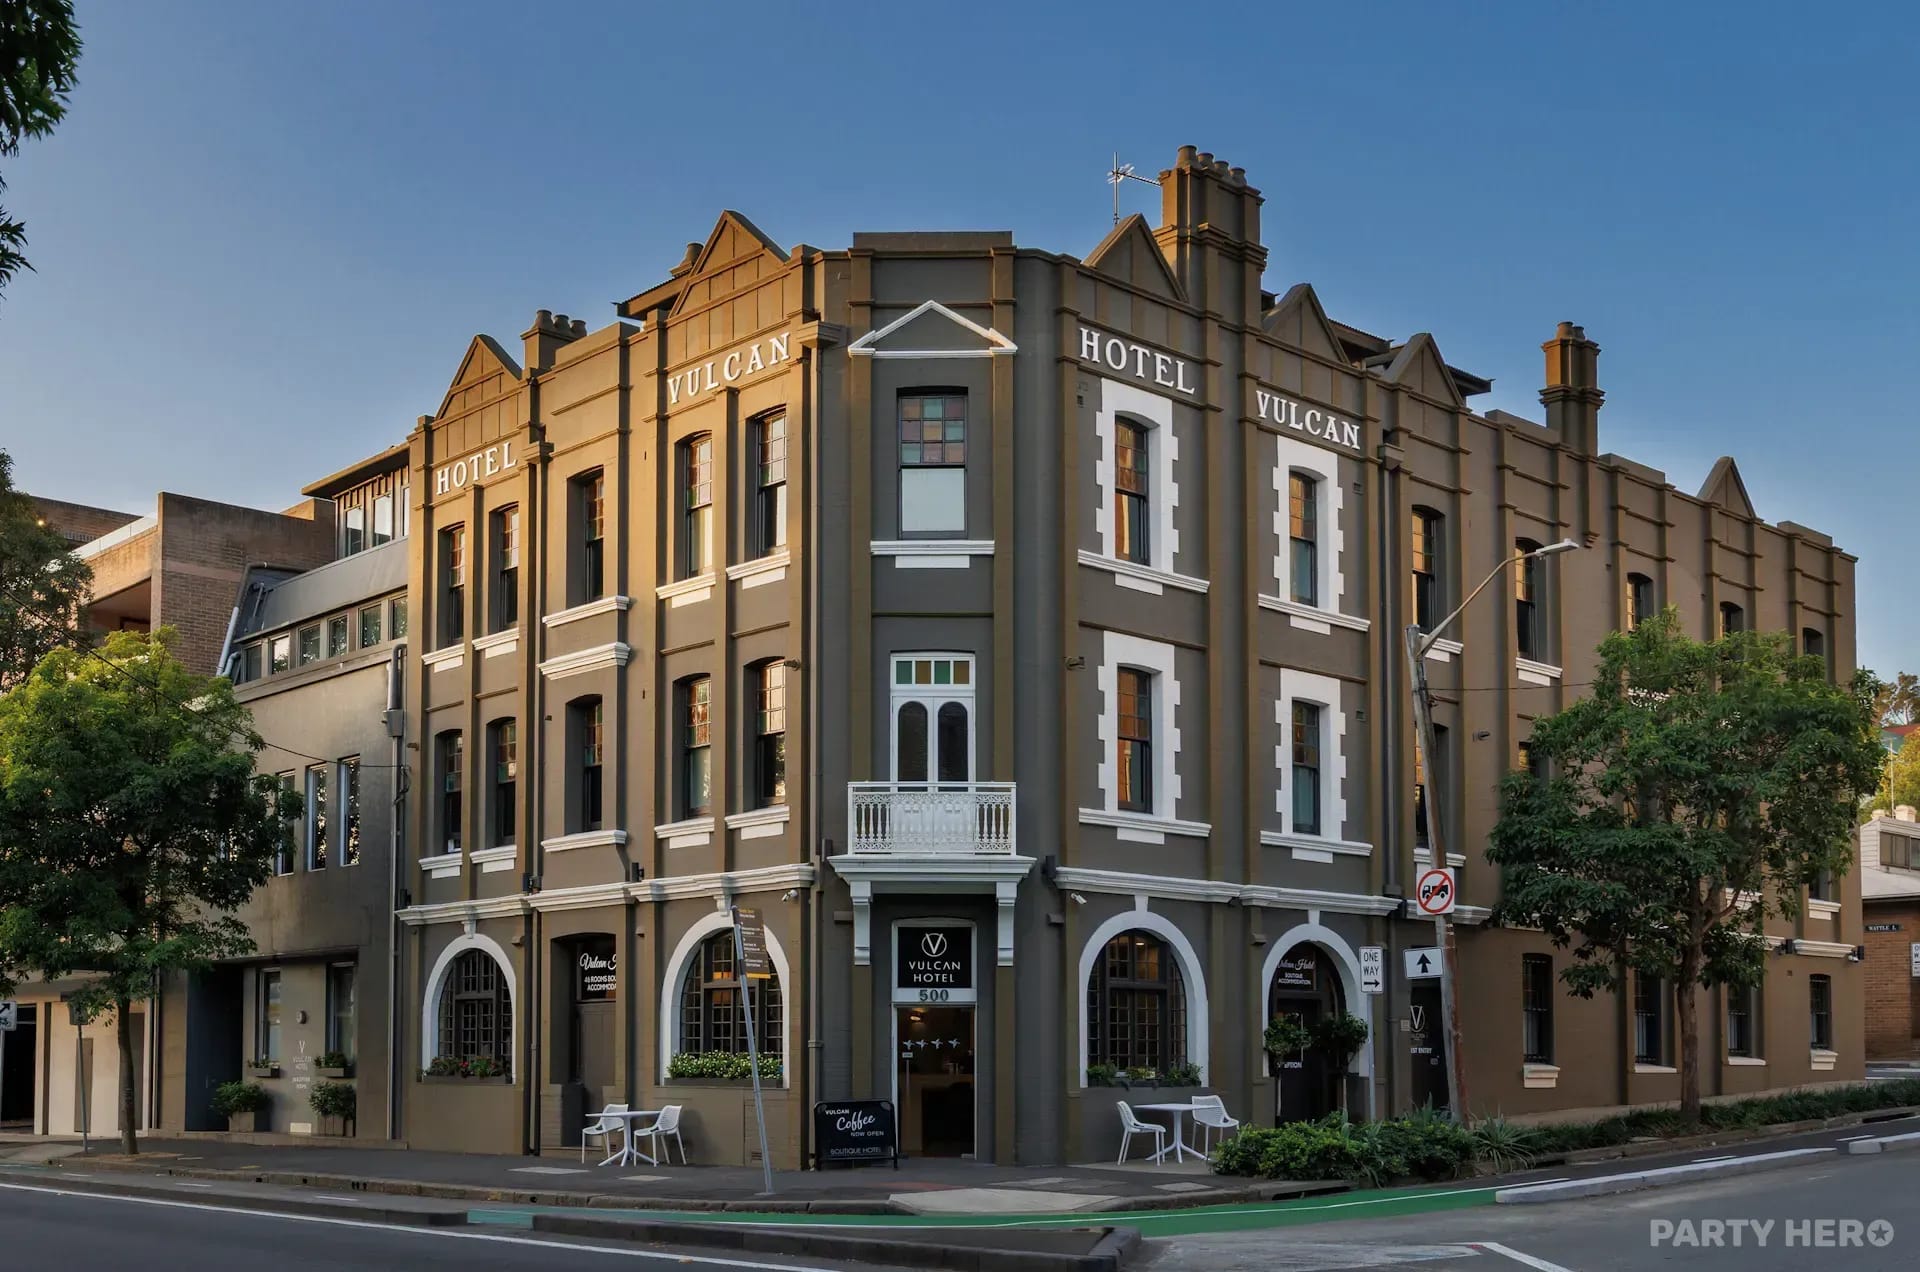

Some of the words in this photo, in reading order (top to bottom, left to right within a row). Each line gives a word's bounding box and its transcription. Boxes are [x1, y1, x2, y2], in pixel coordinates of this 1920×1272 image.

[667, 331, 791, 404] VULCAN
[1079, 327, 1196, 396] HOTEL
[1255, 389, 1361, 450] VULCAN
[436, 441, 518, 496] HOTEL
[580, 953, 607, 970] Vulcan
[909, 961, 961, 970] VULCAN
[1363, 952, 1379, 962] ONE
[913, 973, 955, 983] HOTEL
[1363, 965, 1379, 976] WAY
[919, 989, 949, 1002] 500
[836, 1110, 876, 1131] Coffee
